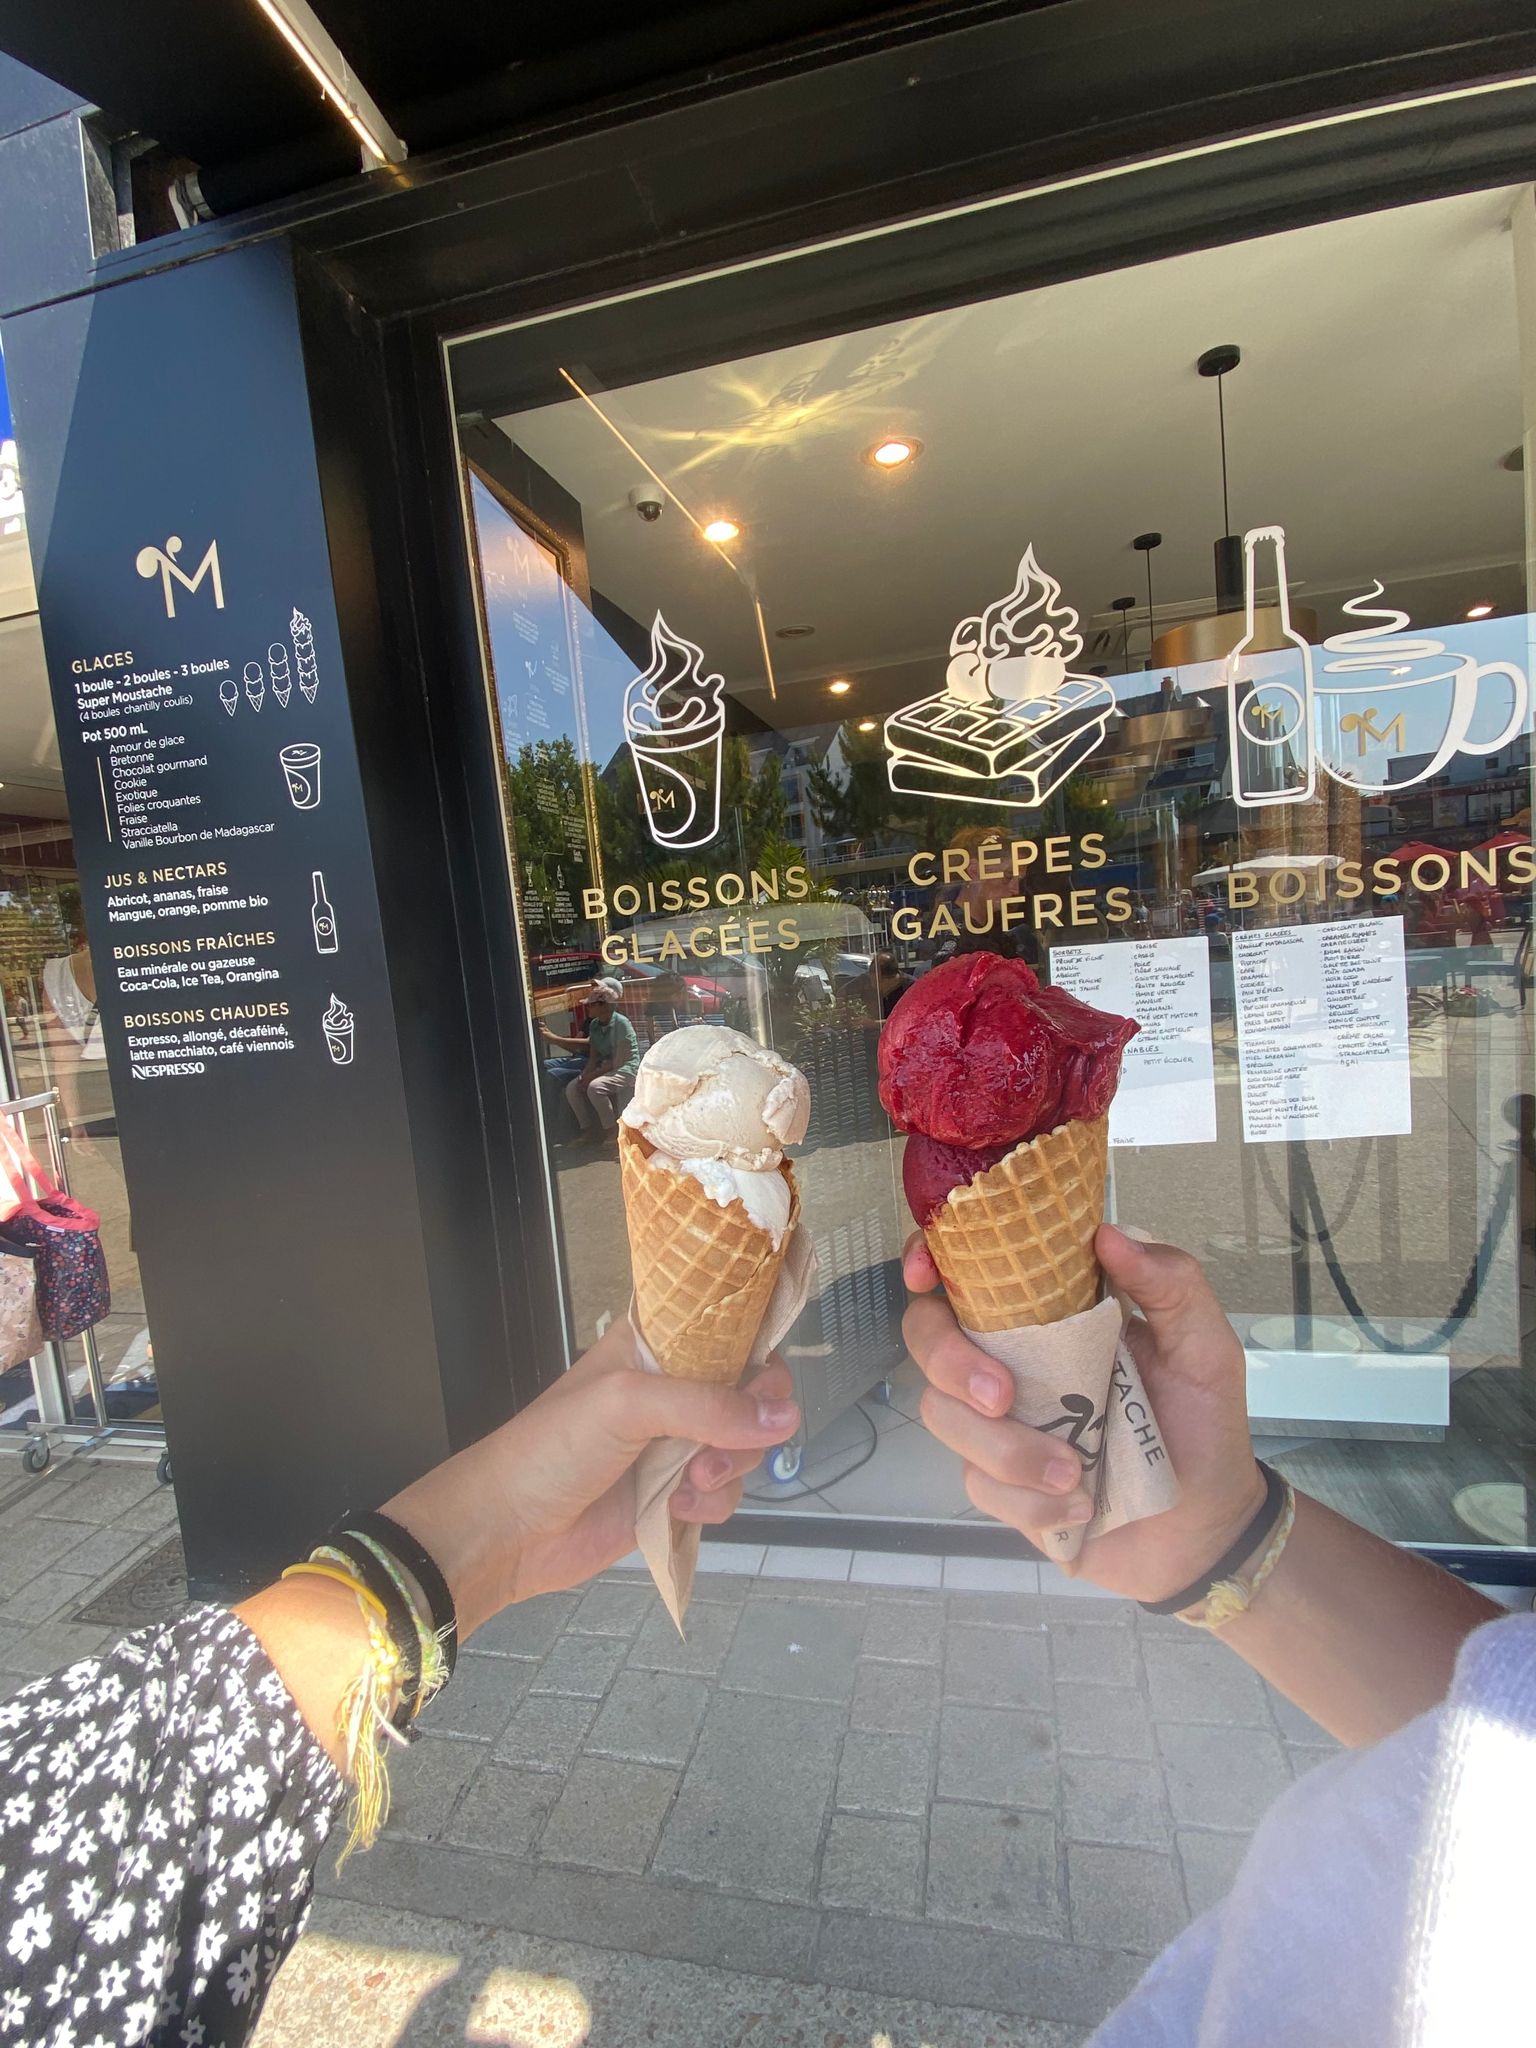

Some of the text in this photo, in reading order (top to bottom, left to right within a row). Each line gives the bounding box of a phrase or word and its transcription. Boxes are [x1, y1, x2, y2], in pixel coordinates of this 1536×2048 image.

[72, 651, 134, 674] GLACES
[75, 684, 80, 694] 1
[83, 678, 113, 693] boule
[124, 675, 131, 686] 2
[133, 669, 171, 685] boules
[181, 665, 188, 676] 3
[191, 659, 229, 675] boules
[78, 685, 172, 710] Super Moustache
[79, 695, 193, 722] (4 boules chantilly coulis)
[83, 723, 148, 743] Pot 500 mL
[109, 735, 185, 754] Amour de glace
[111, 752, 154, 766] Bretonne
[113, 755, 207, 779] Chocolat gourmand
[114, 777, 147, 790] Cookie
[116, 788, 158, 803] Exotique
[118, 795, 201, 814] Folies croquantes
[119, 815, 147, 826] Fraise
[121, 822, 178, 838] Stracciatella
[122, 822, 274, 849] Vanille Bourbon de Madagascar
[908, 833, 1107, 886] CRÊPES
[104, 862, 227, 888] JUS & NECTARS
[1228, 845, 1536, 909] BOISSONS
[107, 885, 228, 908] Abricot, ananas, fraise
[582, 866, 809, 920] BOISSONS
[109, 895, 268, 922] Mangue, orange, pomme bio
[892, 887, 1133, 941] GAUFRES
[113, 932, 276, 959] BOISSONS FRAÎCHES
[601, 916, 801, 965] GLACÉES
[118, 957, 255, 978] Eau minérale ou gazeuse
[120, 969, 279, 992] Coca-Cola, Ice Tea, Orangina
[124, 1002, 289, 1028] BOISSONS CHAUDES
[128, 1024, 288, 1049] Expresso, allongé, décaféiné,
[130, 1039, 294, 1061] latte macchiato, café viennois
[132, 1062, 205, 1080] NESPRESSO
